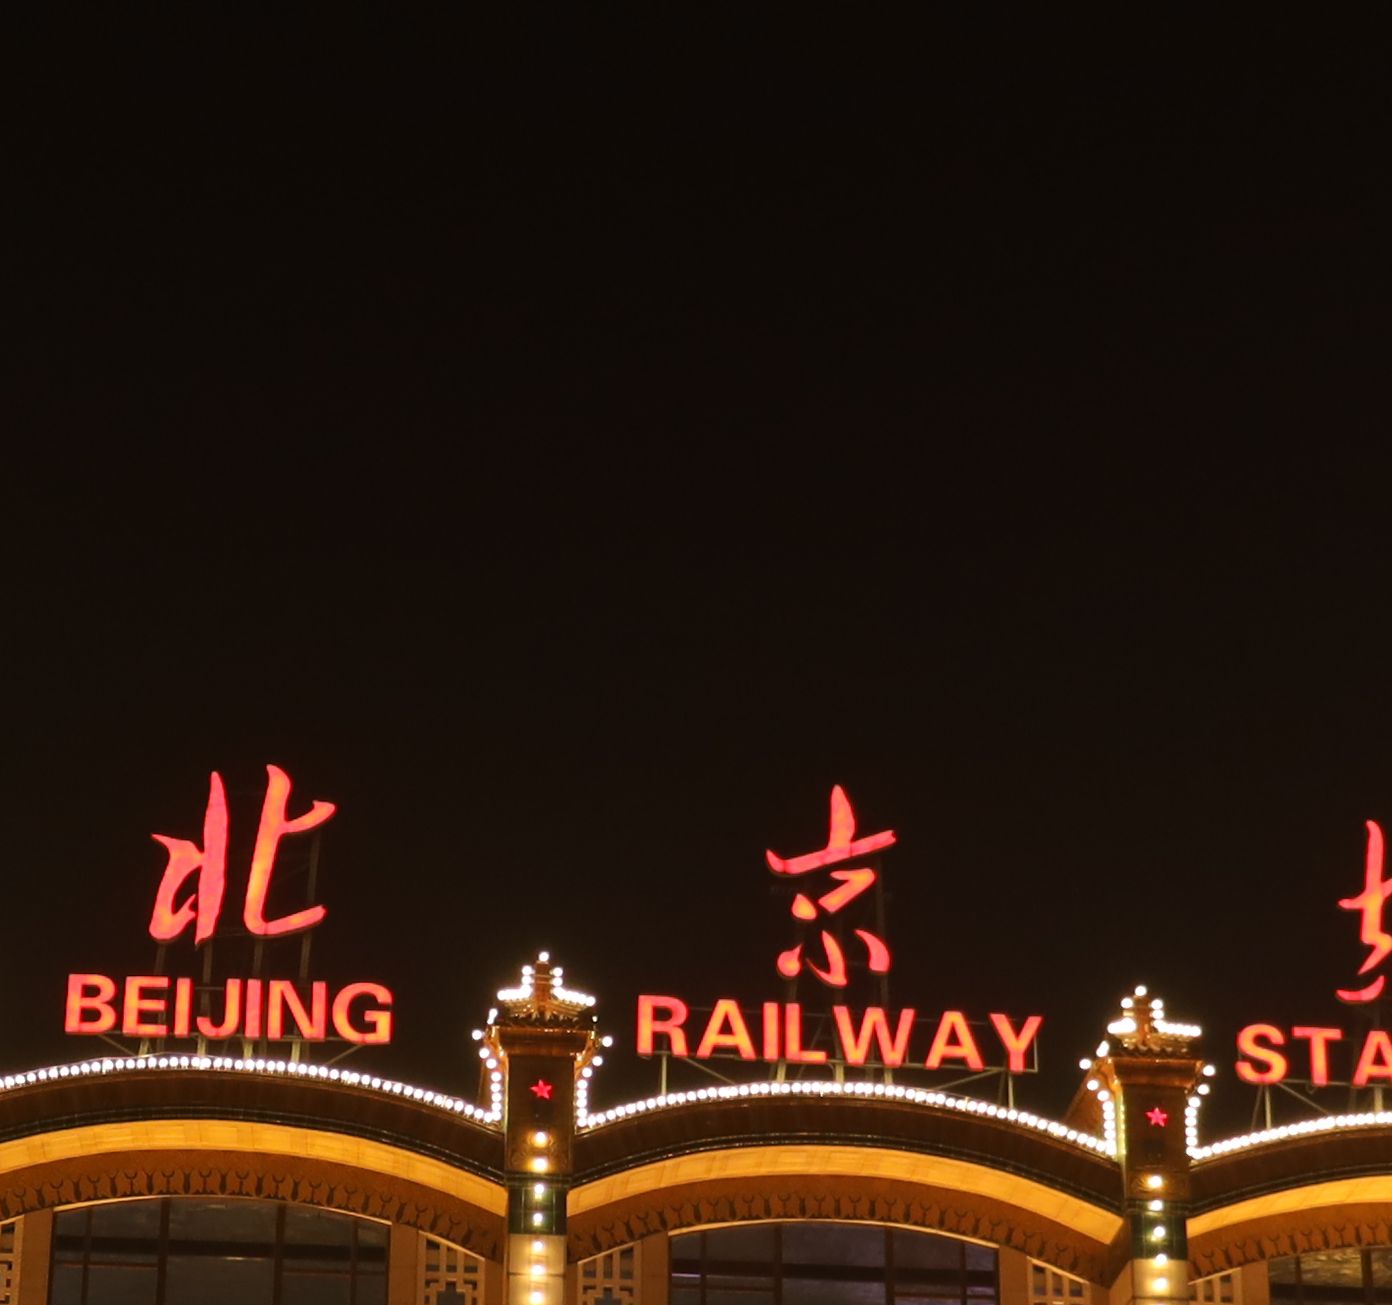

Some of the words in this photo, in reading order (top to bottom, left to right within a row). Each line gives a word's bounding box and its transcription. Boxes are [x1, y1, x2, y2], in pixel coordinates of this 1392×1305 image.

[149, 764, 335, 945] 北
[765, 783, 896, 987] 京
[64, 972, 393, 1045] BEIJING
[636, 994, 1043, 1074] RAILWAY
